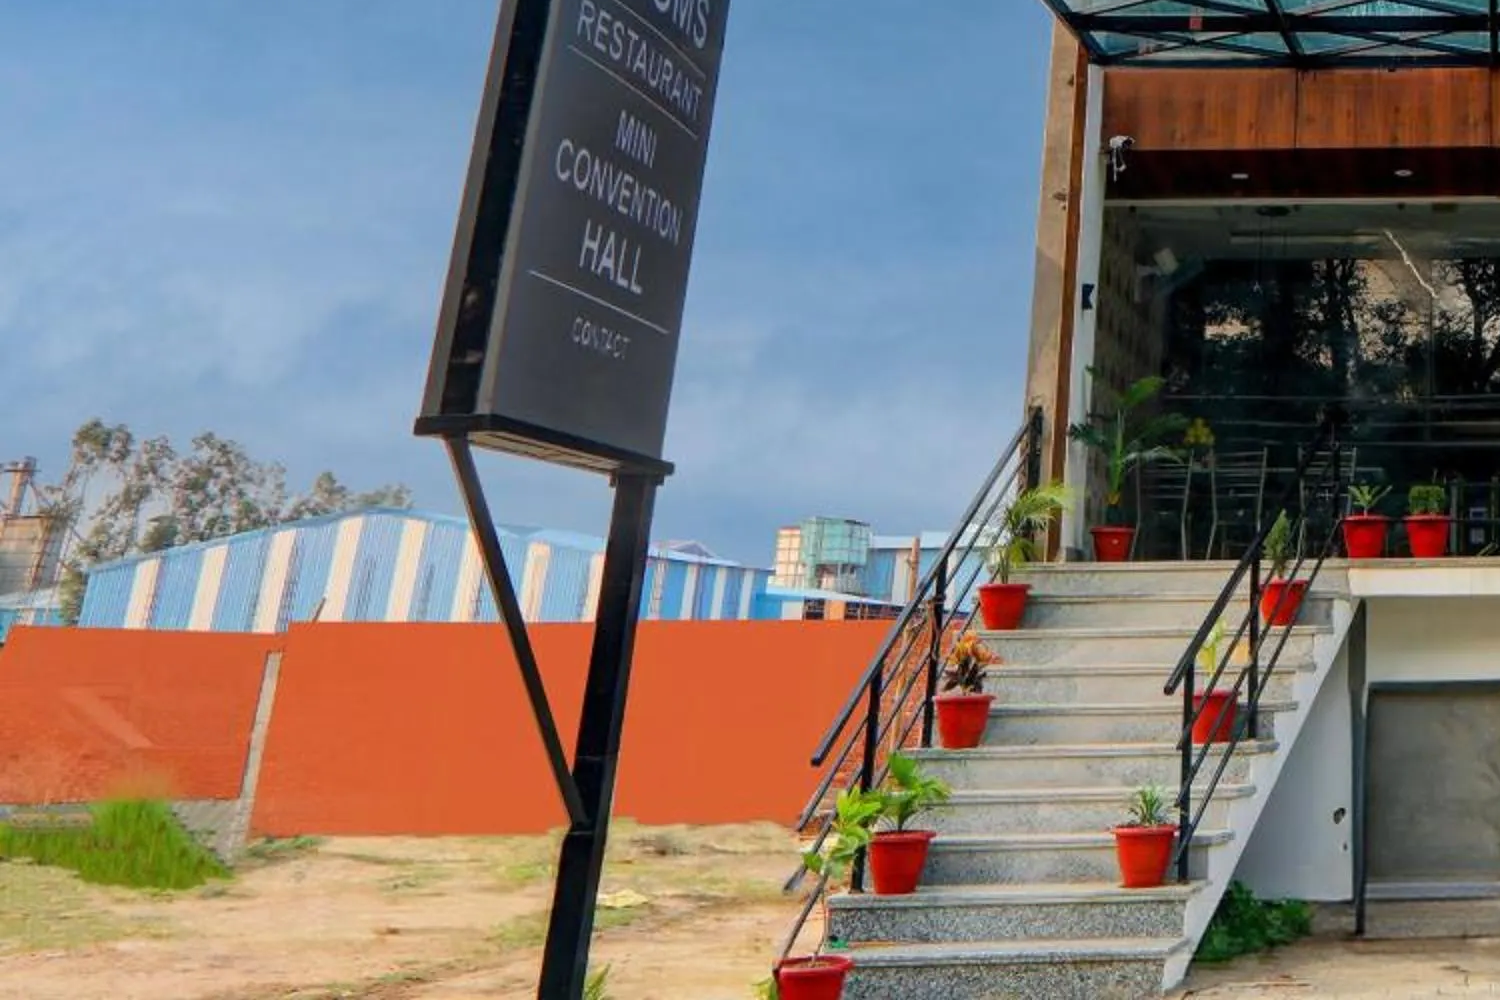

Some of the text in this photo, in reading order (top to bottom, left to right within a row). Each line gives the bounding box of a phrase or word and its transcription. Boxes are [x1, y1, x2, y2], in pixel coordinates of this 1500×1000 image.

[577, 0, 702, 122] RESTAURANT
[615, 110, 658, 169] MINI
[555, 138, 683, 246] CONVENTION
[578, 219, 643, 295] HALL
[571, 316, 631, 361] CONTACT
